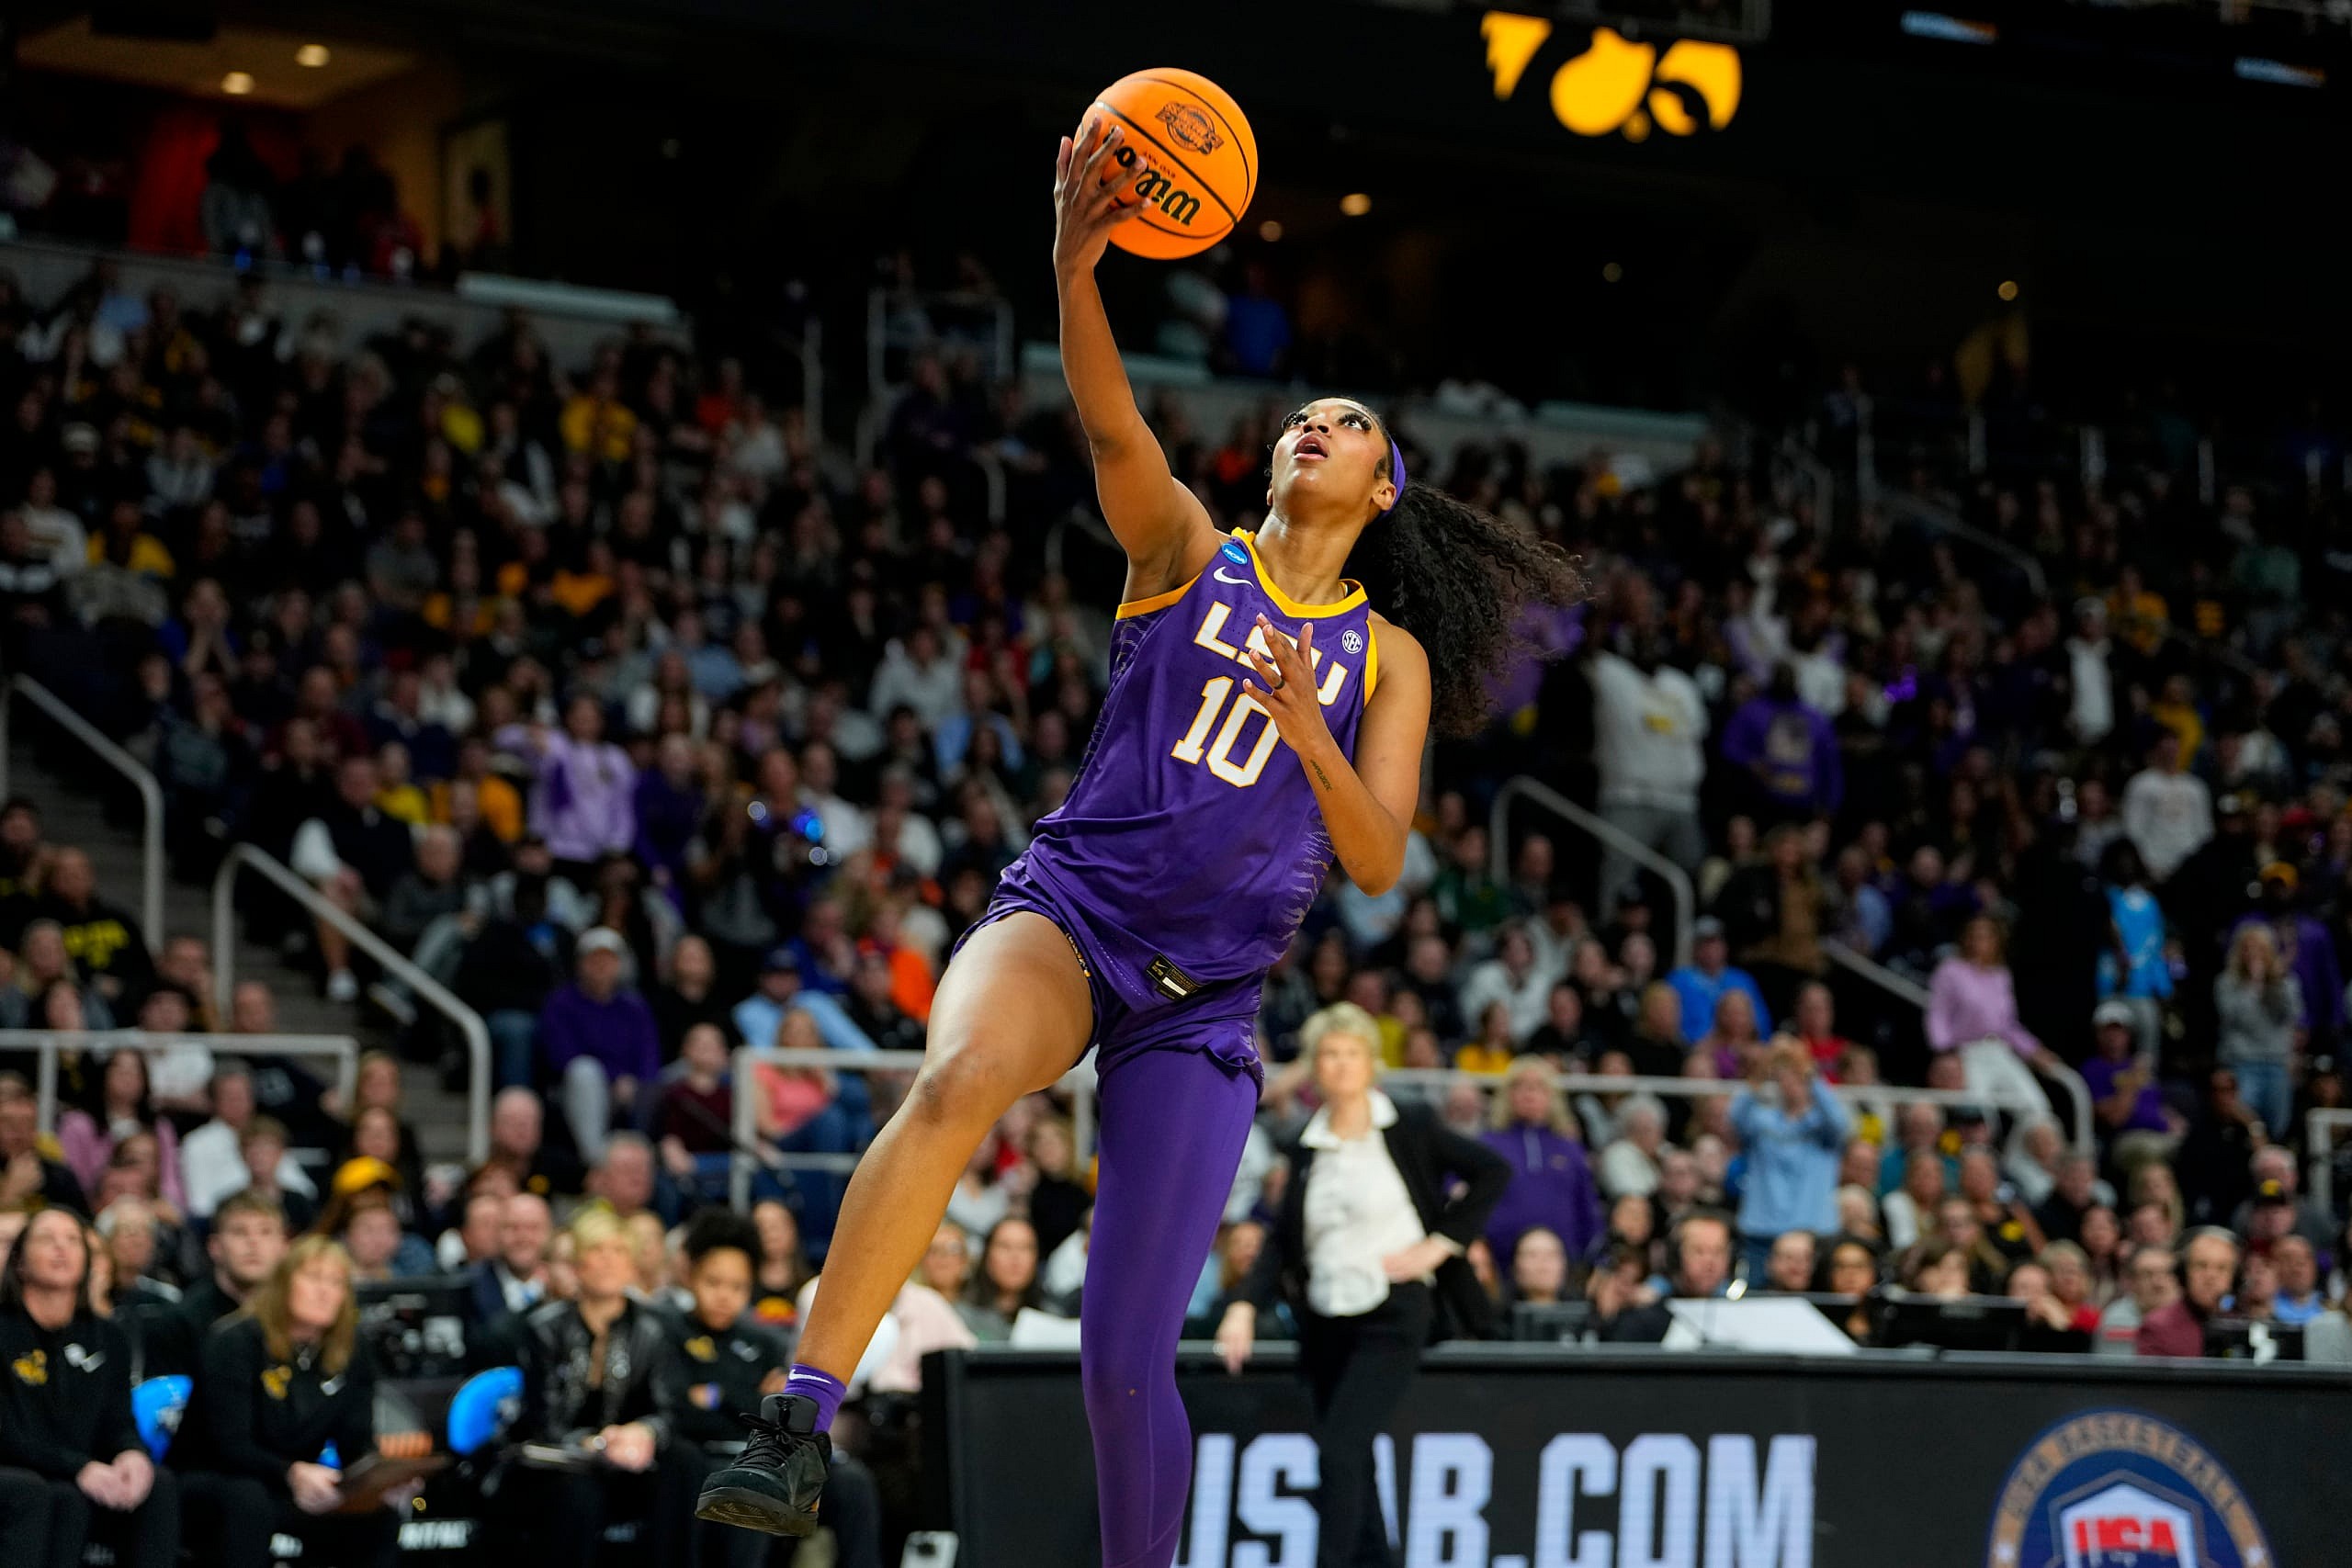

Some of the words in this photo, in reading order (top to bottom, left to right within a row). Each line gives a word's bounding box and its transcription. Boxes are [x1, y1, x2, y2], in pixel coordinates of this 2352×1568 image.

[1102, 126, 1201, 226] Wilo
[1170, 675, 1281, 788] 10
[1170, 1432, 1817, 1568] USB.COM
